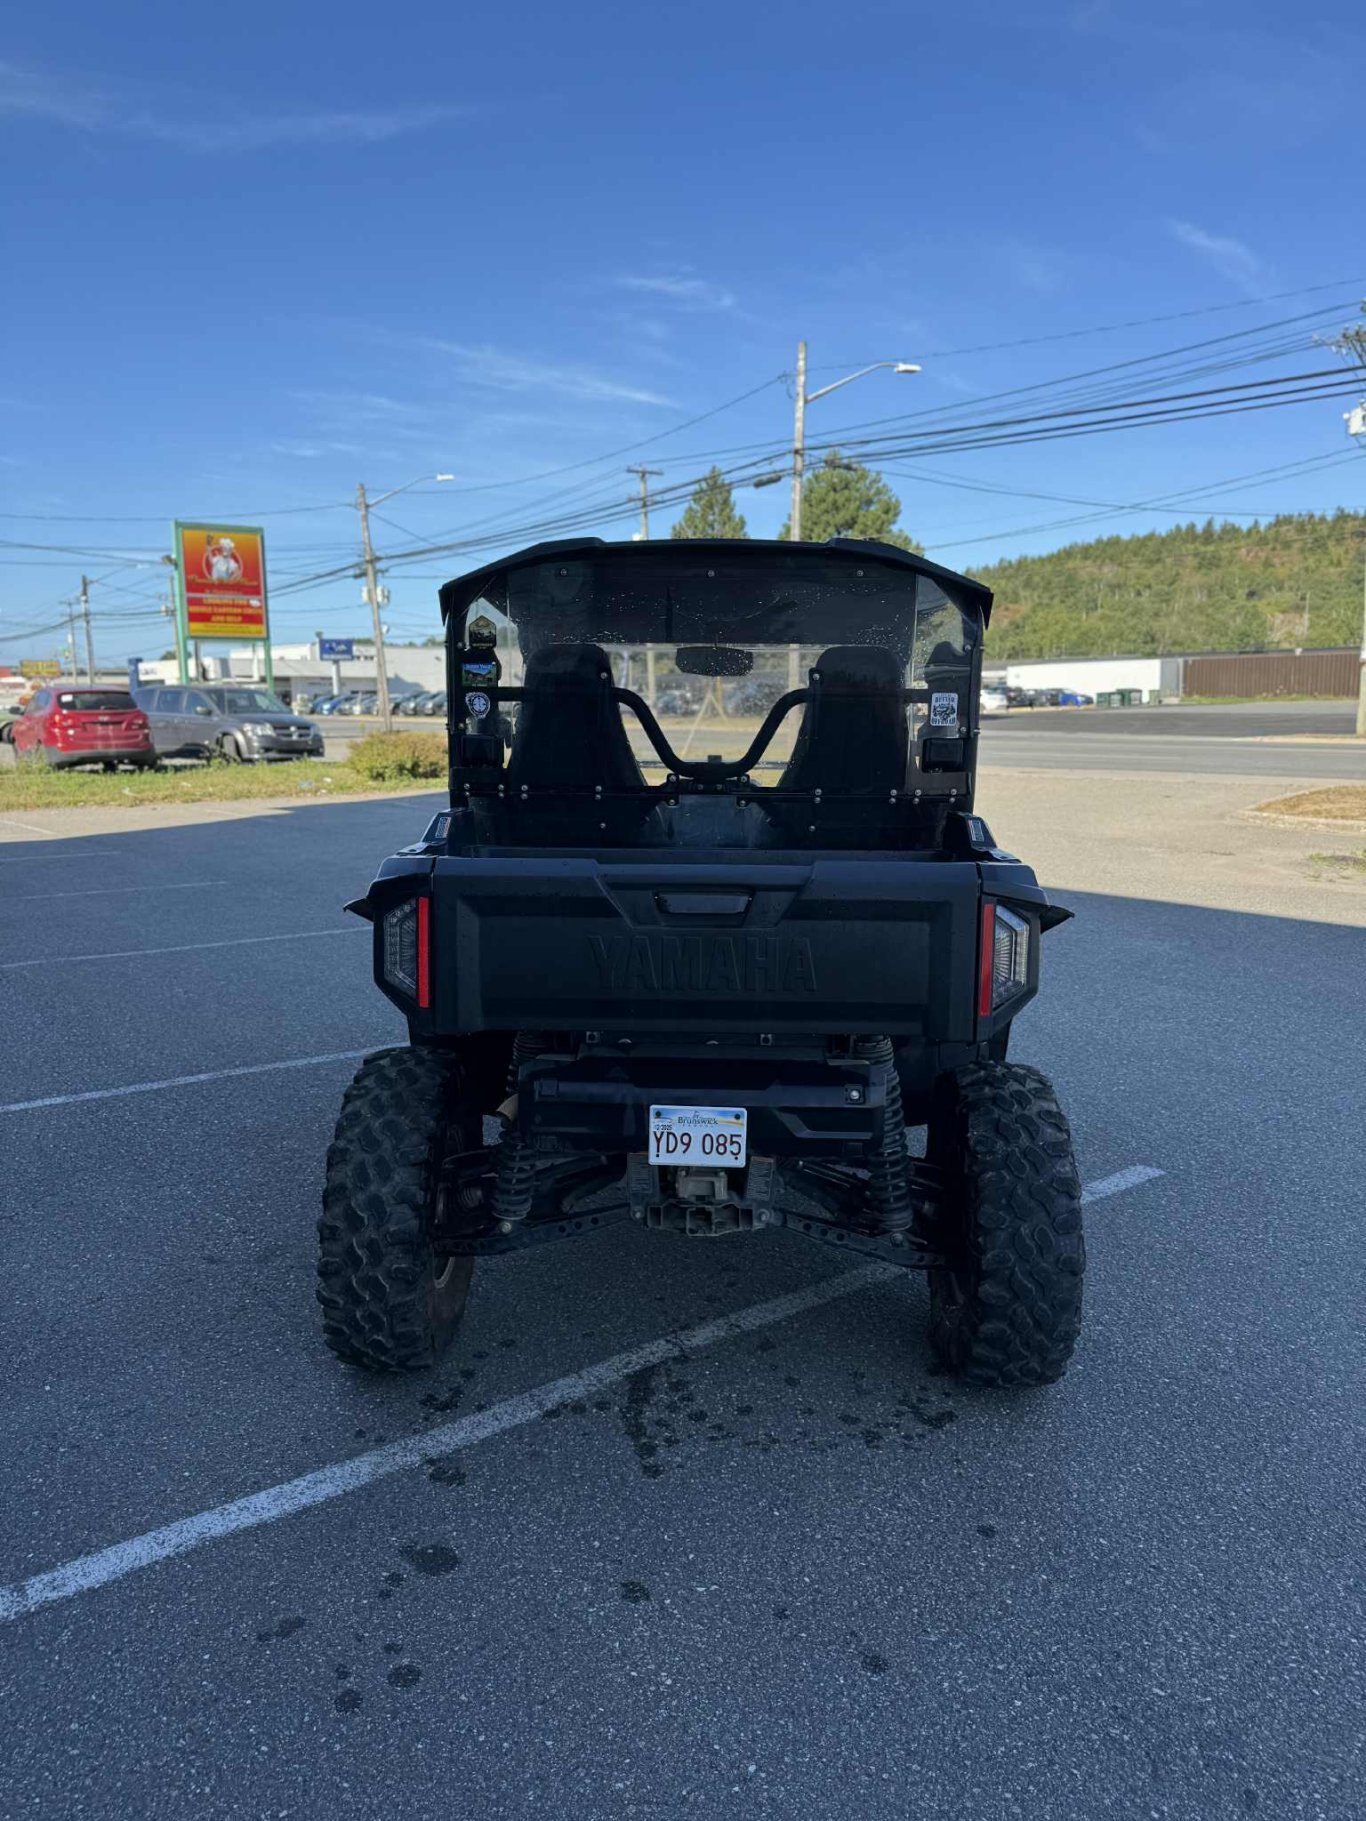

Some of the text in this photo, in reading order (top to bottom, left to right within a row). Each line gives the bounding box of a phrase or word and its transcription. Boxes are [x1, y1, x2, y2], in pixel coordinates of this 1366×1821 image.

[587, 935, 817, 992] YAMAHA
[677, 1116, 718, 1125] Brunswick
[653, 1131, 742, 1156] YD9 085
